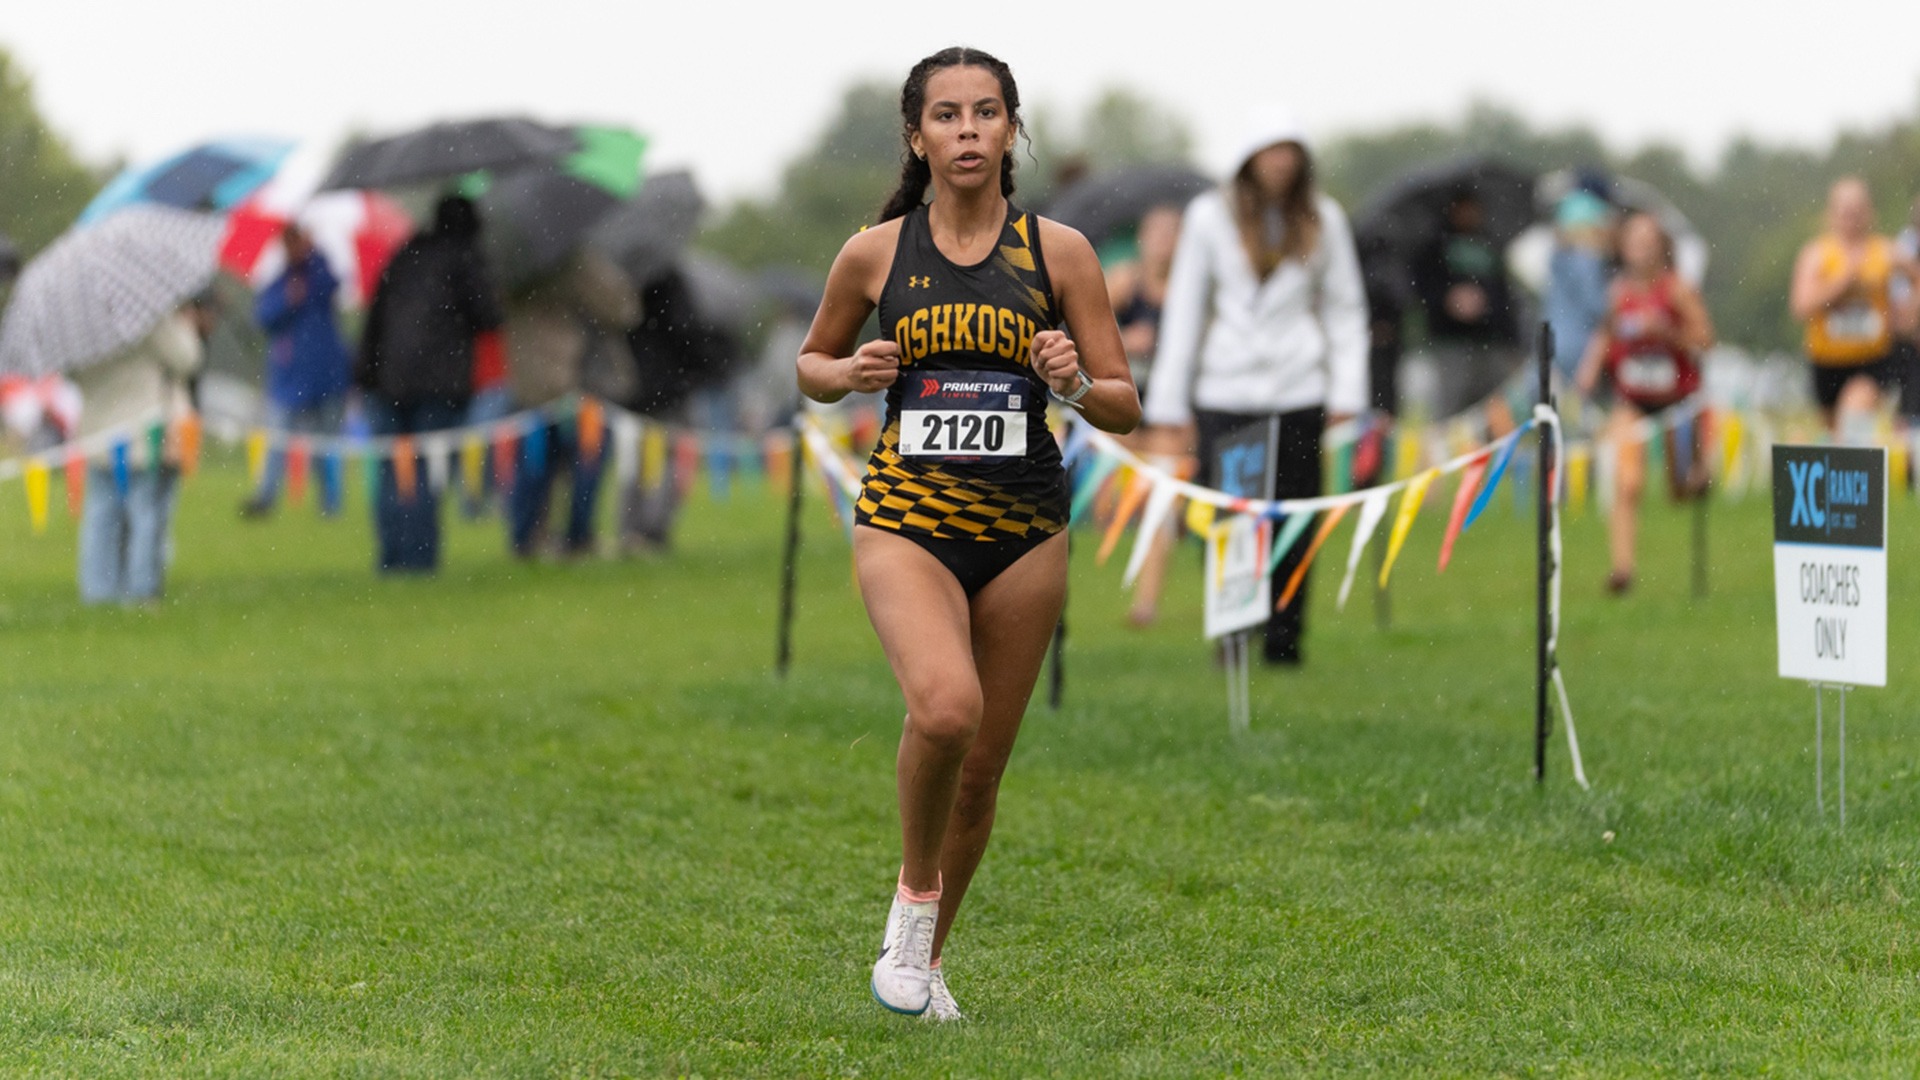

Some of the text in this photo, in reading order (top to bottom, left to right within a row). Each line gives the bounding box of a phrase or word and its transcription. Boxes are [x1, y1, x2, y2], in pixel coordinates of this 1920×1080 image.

[895, 303, 1036, 368] OSHKOSH
[942, 382, 1011, 392] PRIMETIME
[922, 414, 1005, 452] 2120
[1788, 460, 1869, 529] XC RANCH
[1800, 562, 1860, 607] COACHES
[1815, 616, 1848, 660] ONLY
